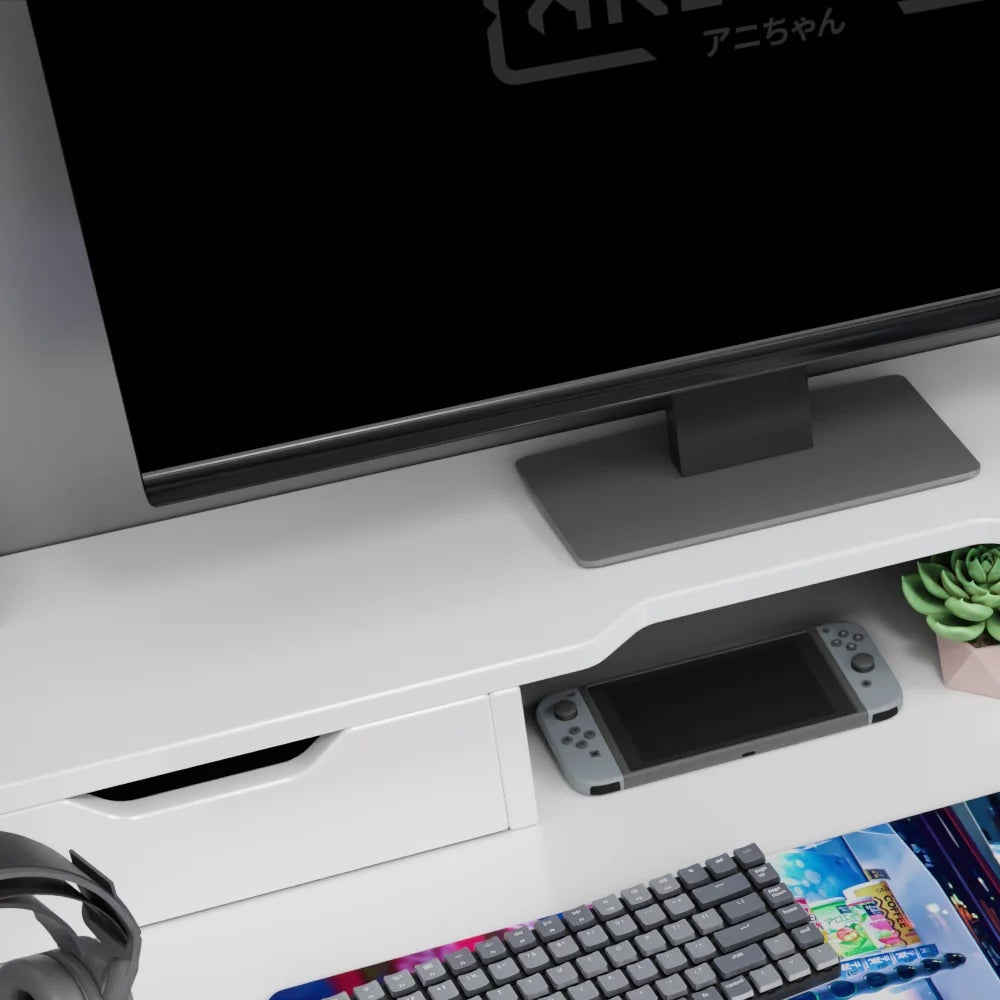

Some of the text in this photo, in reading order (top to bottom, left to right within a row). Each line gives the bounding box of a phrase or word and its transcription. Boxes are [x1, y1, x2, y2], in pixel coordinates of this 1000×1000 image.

[703, 7, 846, 58] アニちゃん
[884, 895, 906, 928] COFFEE
